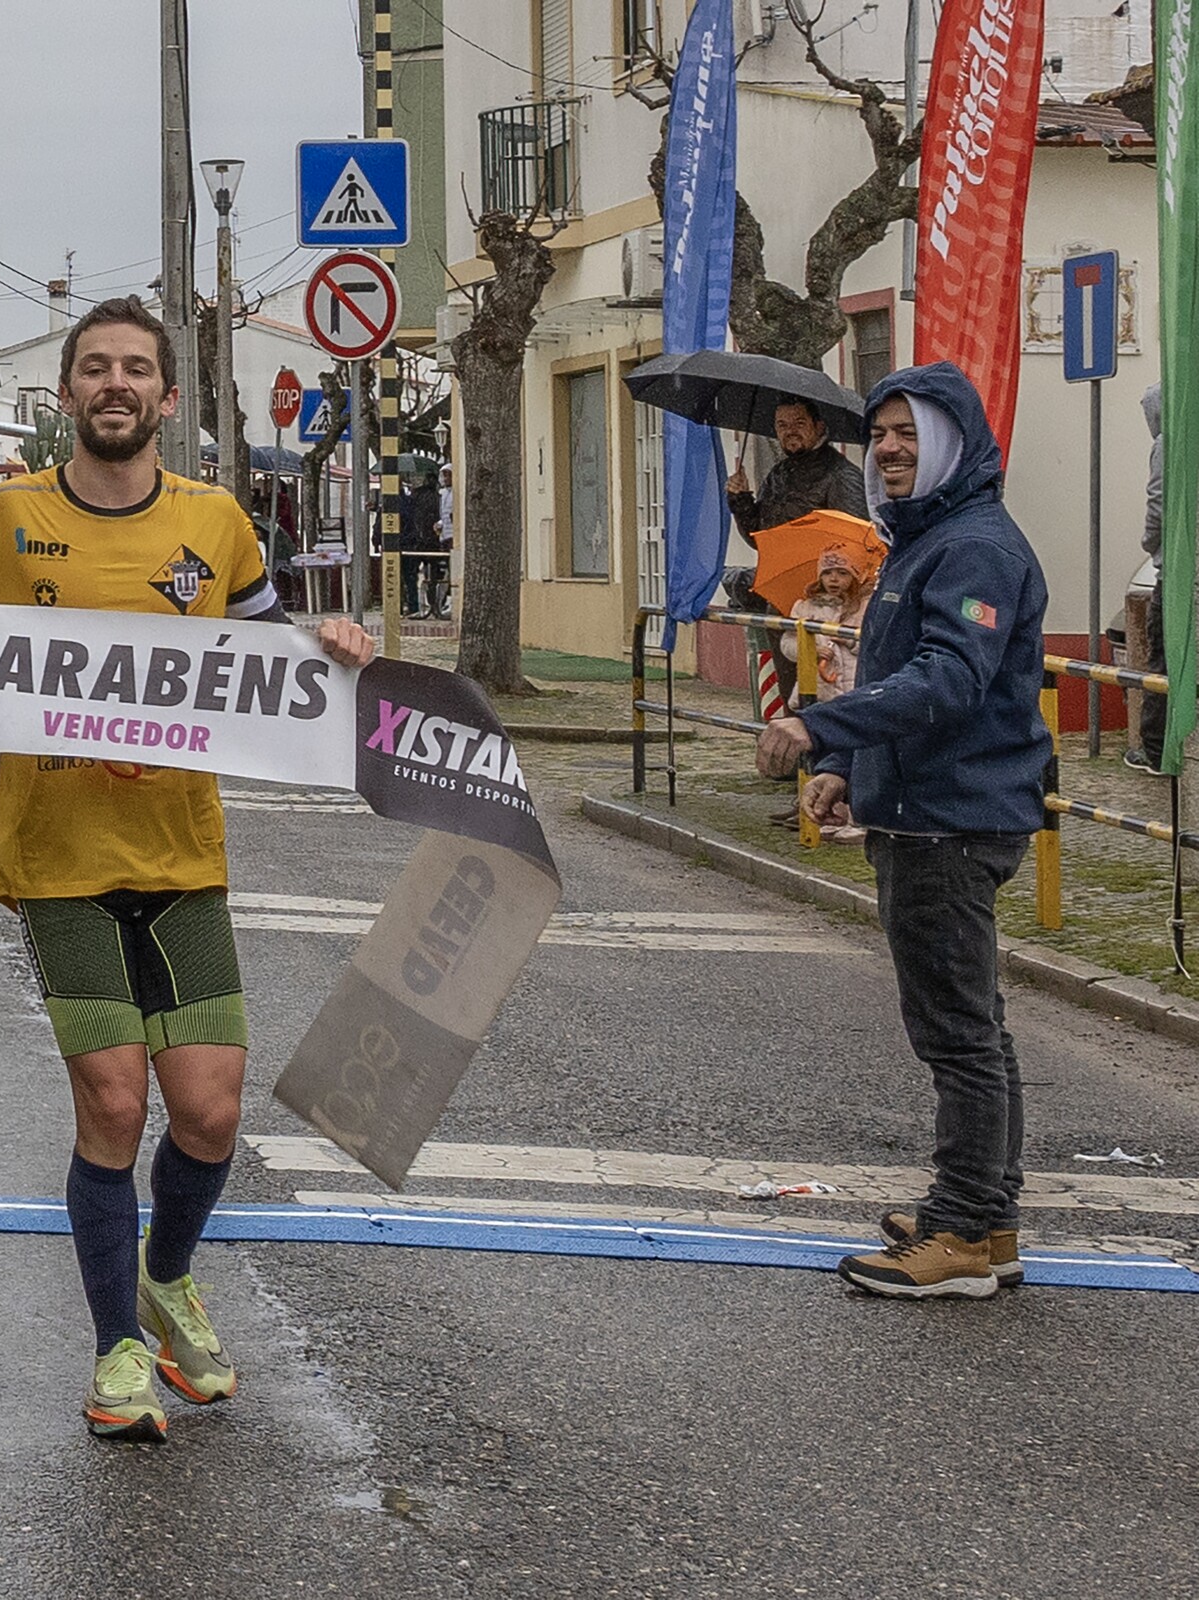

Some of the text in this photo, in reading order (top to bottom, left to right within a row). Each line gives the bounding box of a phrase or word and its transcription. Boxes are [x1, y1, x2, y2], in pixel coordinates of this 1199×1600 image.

[273, 389, 299, 409] STOP
[43, 710, 211, 753] VENCEDOR
[394, 765, 456, 790] EVENTOS
